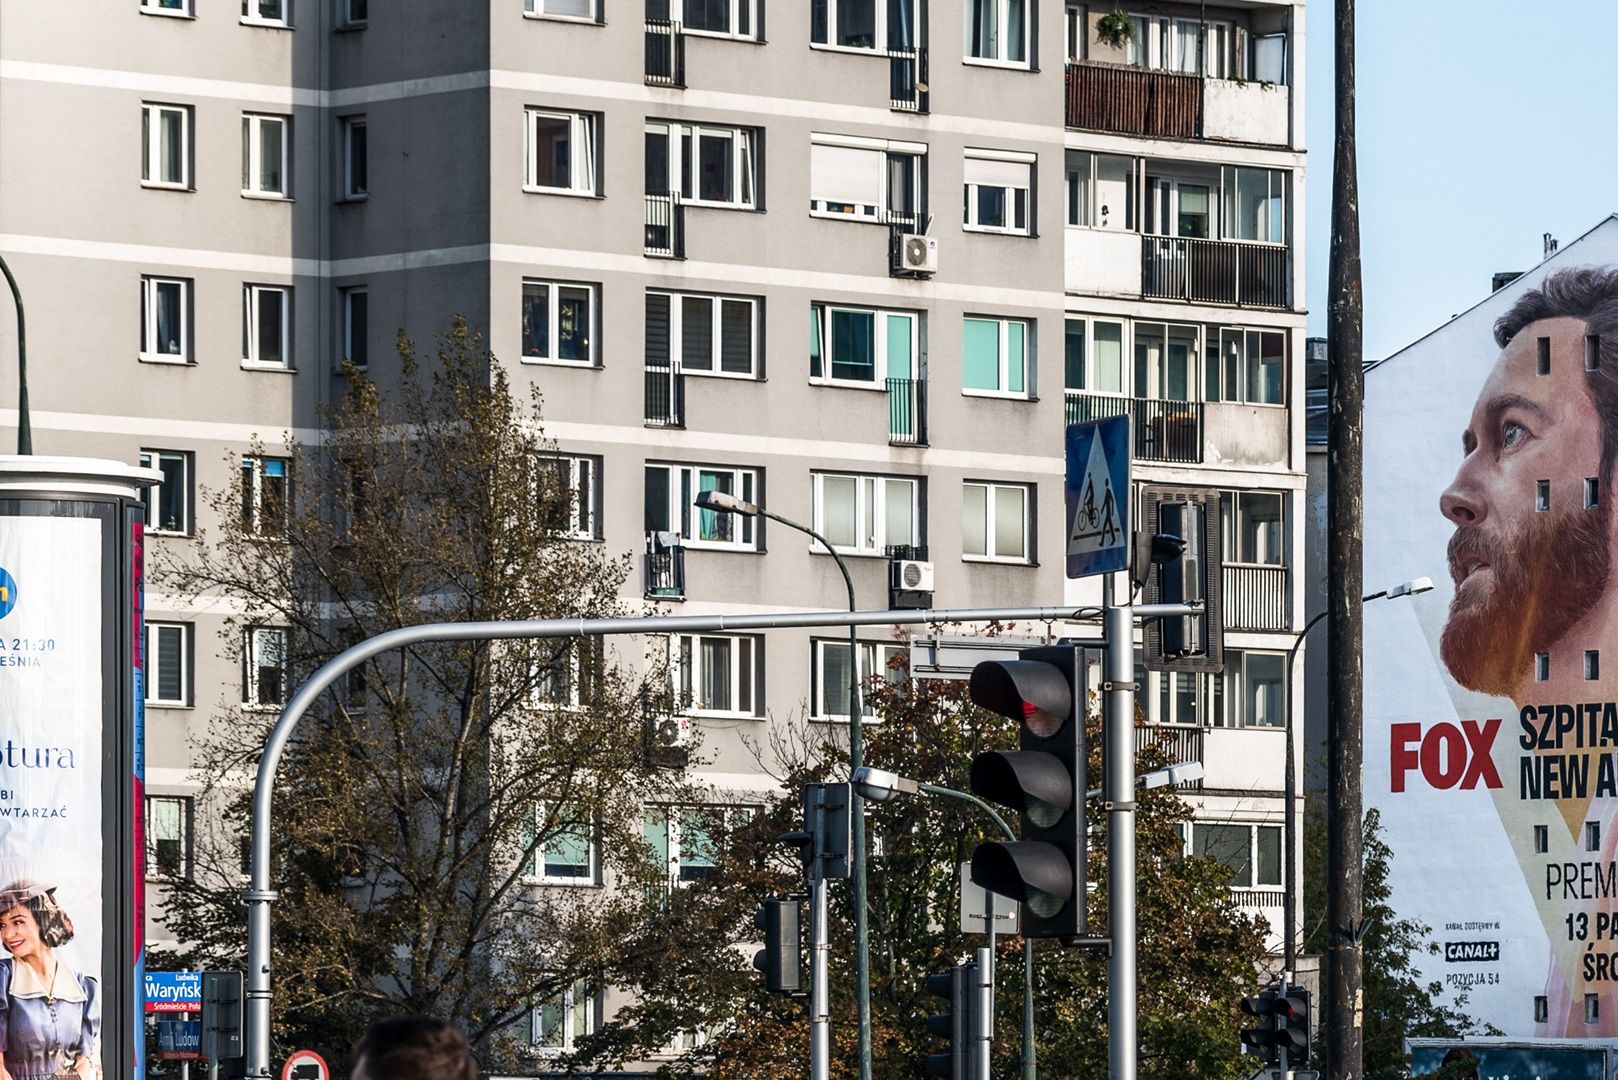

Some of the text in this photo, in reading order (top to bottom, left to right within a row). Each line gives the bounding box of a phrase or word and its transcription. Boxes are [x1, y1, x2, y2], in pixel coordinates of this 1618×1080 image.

[12, 637, 55, 652] 21:30
[0, 652, 41, 667] EŚNIA
[1390, 718, 1504, 793] FOX
[1519, 754, 1590, 800] NEW
[1565, 911, 1589, 941] 13
[175, 973, 199, 981] Ludwika
[1446, 972, 1500, 986] POZYCJA 54
